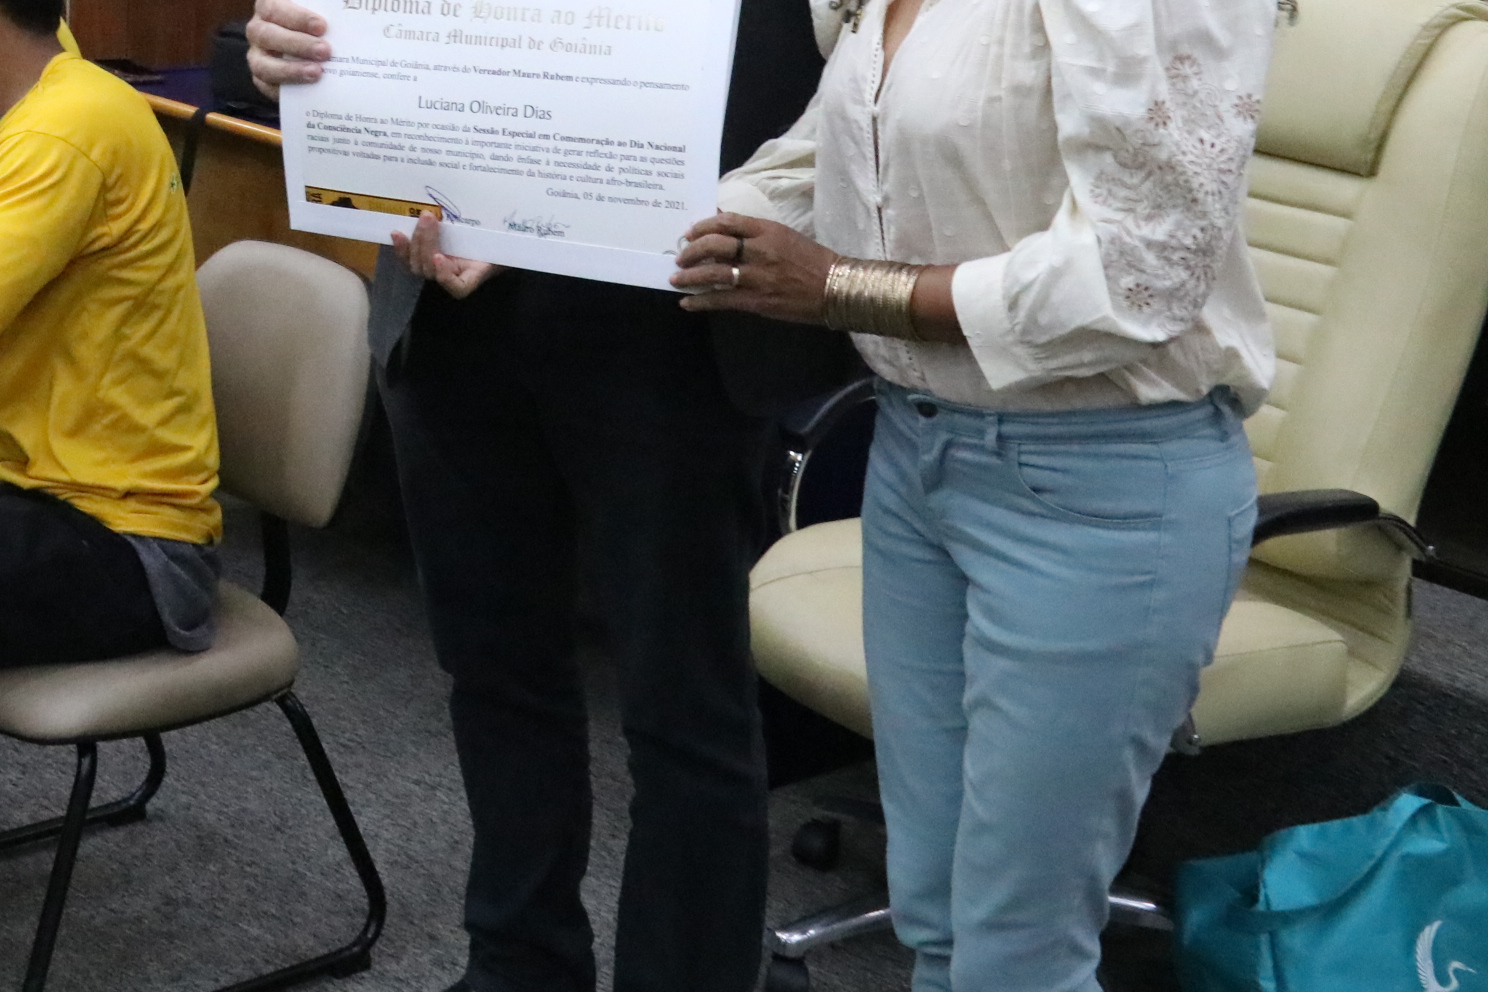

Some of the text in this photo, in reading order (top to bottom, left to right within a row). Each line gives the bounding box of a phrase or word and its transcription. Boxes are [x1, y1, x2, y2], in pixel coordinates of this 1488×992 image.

[551, 9, 575, 26] ao
[383, 23, 612, 56] Câmara Municipal de Goiânia
[351, 56, 388, 67] Municipal
[390, 60, 399, 68] de
[433, 63, 459, 73] através
[461, 64, 471, 73] do
[472, 65, 511, 77] Vereador
[512, 68, 541, 80] Mauro
[542, 71, 573, 82] Rubem
[581, 76, 632, 88] expressando
[639, 80, 690, 92] pensamento
[383, 72, 411, 81] confere
[418, 95, 552, 120] Luciana Oliveira Dias
[306, 121, 316, 129] da
[317, 122, 362, 134] Consciência
[364, 127, 389, 138] Negra,
[404, 132, 463, 144] reconhecimento
[471, 139, 512, 150] importante
[514, 143, 550, 154] iniciativa
[552, 146, 561, 155] de
[563, 148, 583, 158] gerar
[585, 149, 618, 160] reflexão
[620, 153, 637, 162] para
[650, 156, 685, 166] questões
[312, 109, 343, 120] Diploma
[344, 112, 353, 121] de
[354, 113, 378, 124] Honra
[390, 117, 416, 127] Mérito
[417, 121, 430, 130] por
[431, 122, 460, 132] ocasião
[461, 124, 471, 133] da
[473, 125, 499, 135] Sessão
[501, 128, 536, 139] Especial
[552, 132, 614, 147] Comemoração
[617, 140, 627, 148] ao
[629, 139, 644, 149] Dia
[647, 141, 686, 153] Nacional
[332, 135, 351, 145] junto
[361, 139, 406, 151] comunidade
[408, 144, 417, 152] de
[420, 147, 442, 155] nosso
[489, 153, 513, 162] dando
[553, 160, 601, 171] necessidade
[605, 163, 614, 172] de
[618, 166, 653, 176] políticas
[656, 170, 685, 179] sociais
[352, 150, 381, 160] voltadas
[383, 155, 399, 163] para
[439, 160, 460, 170] social
[469, 162, 525, 176] fortalecimento
[526, 168, 536, 177] da
[537, 169, 567, 181] história
[576, 175, 604, 185] cultura
[606, 177, 666, 190] afro-brasileira.
[583, 191, 593, 201] 05
[595, 193, 606, 202] de
[608, 196, 650, 207] novembro
[652, 199, 662, 208] de
